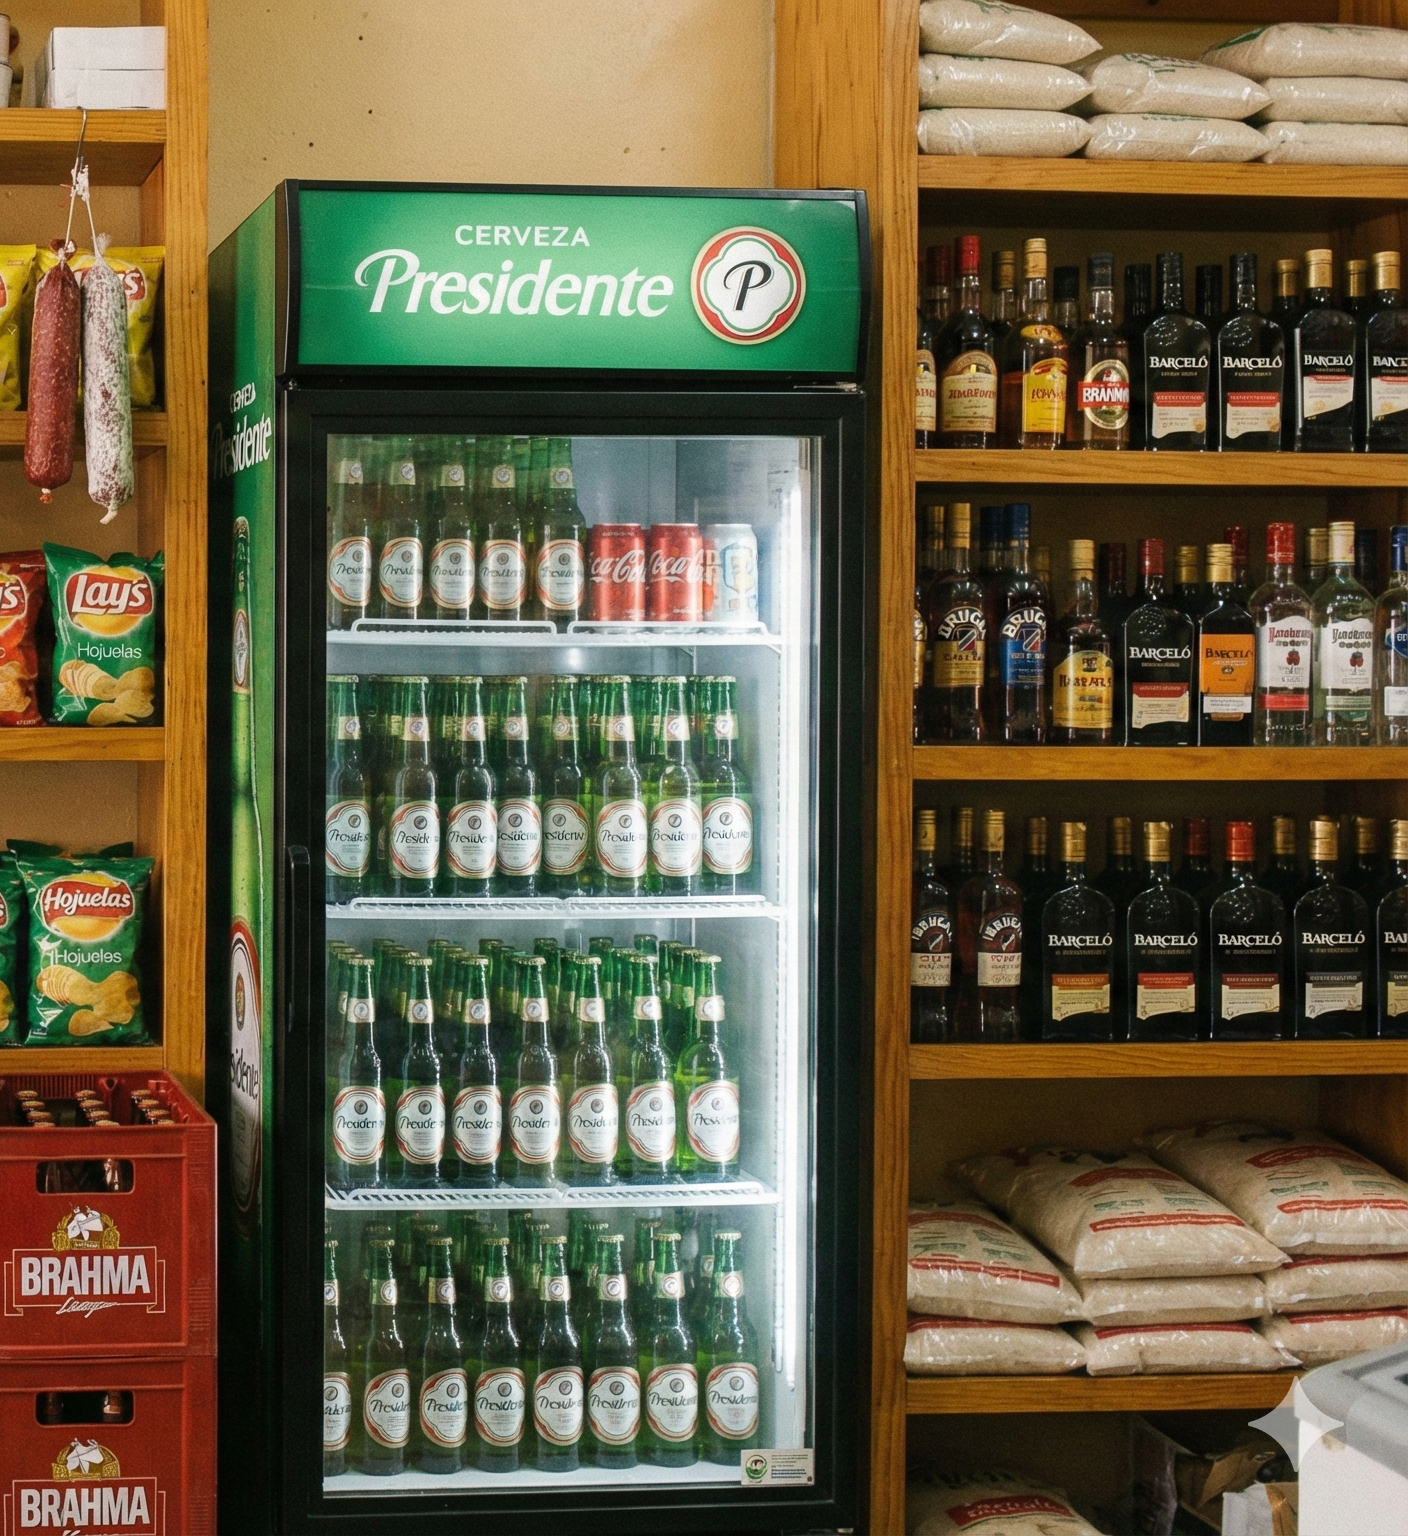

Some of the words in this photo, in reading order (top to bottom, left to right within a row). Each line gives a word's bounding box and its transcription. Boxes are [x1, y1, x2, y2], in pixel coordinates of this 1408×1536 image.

[455, 224, 590, 247] CERVEZA
[354, 248, 674, 318] Presidente
[724, 259, 772, 312] P
[72, 574, 148, 615] Lay's
[77, 642, 142, 661] Hojuelas
[1129, 645, 1191, 662] BARCELÓ
[44, 887, 131, 916] Hojuelas
[1048, 932, 1113, 949] BARCELÓ
[1134, 931, 1198, 948] BARCELÓ
[1218, 931, 1282, 948] BARCELÓ
[1302, 930, 1366, 946] BARCELÓ
[21, 1254, 151, 1296] BRAHMA
[20, 1486, 151, 1528] BRAHMA
